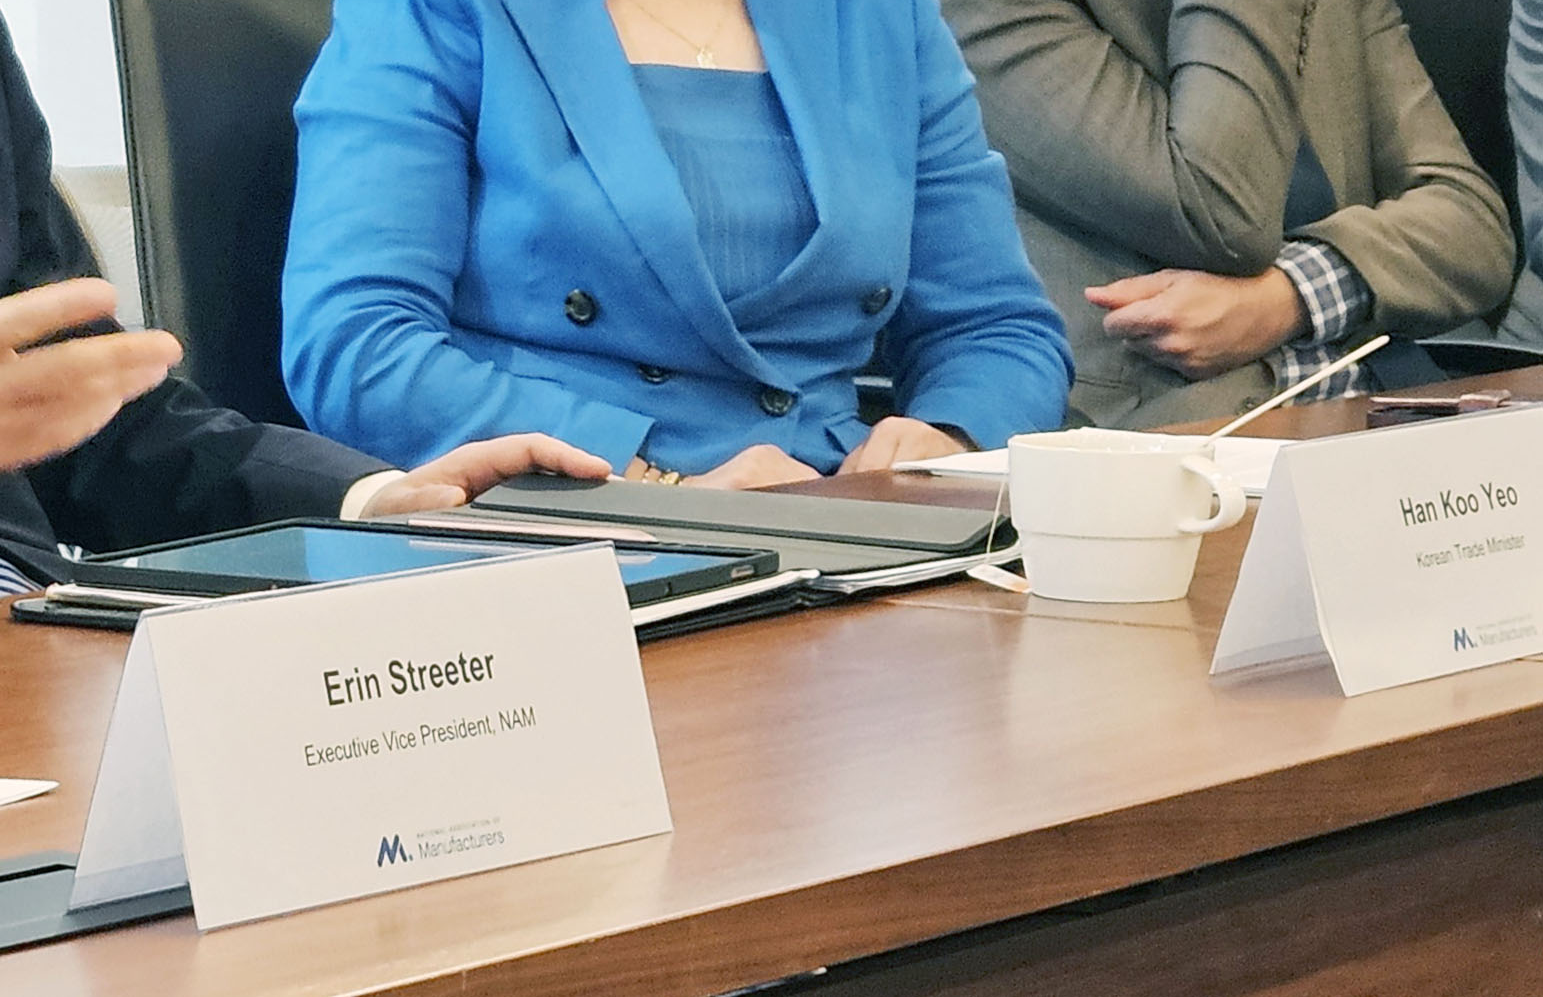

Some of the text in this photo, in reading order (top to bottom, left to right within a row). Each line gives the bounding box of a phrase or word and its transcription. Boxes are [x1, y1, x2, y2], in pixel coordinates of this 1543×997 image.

[1399, 482, 1518, 526] Han Koo Yeo
[1416, 550, 1453, 568] Korean
[1454, 542, 1485, 559] Trade
[323, 652, 494, 706] Erin Streeter
[304, 706, 537, 766] Executive Vice President, NAM
